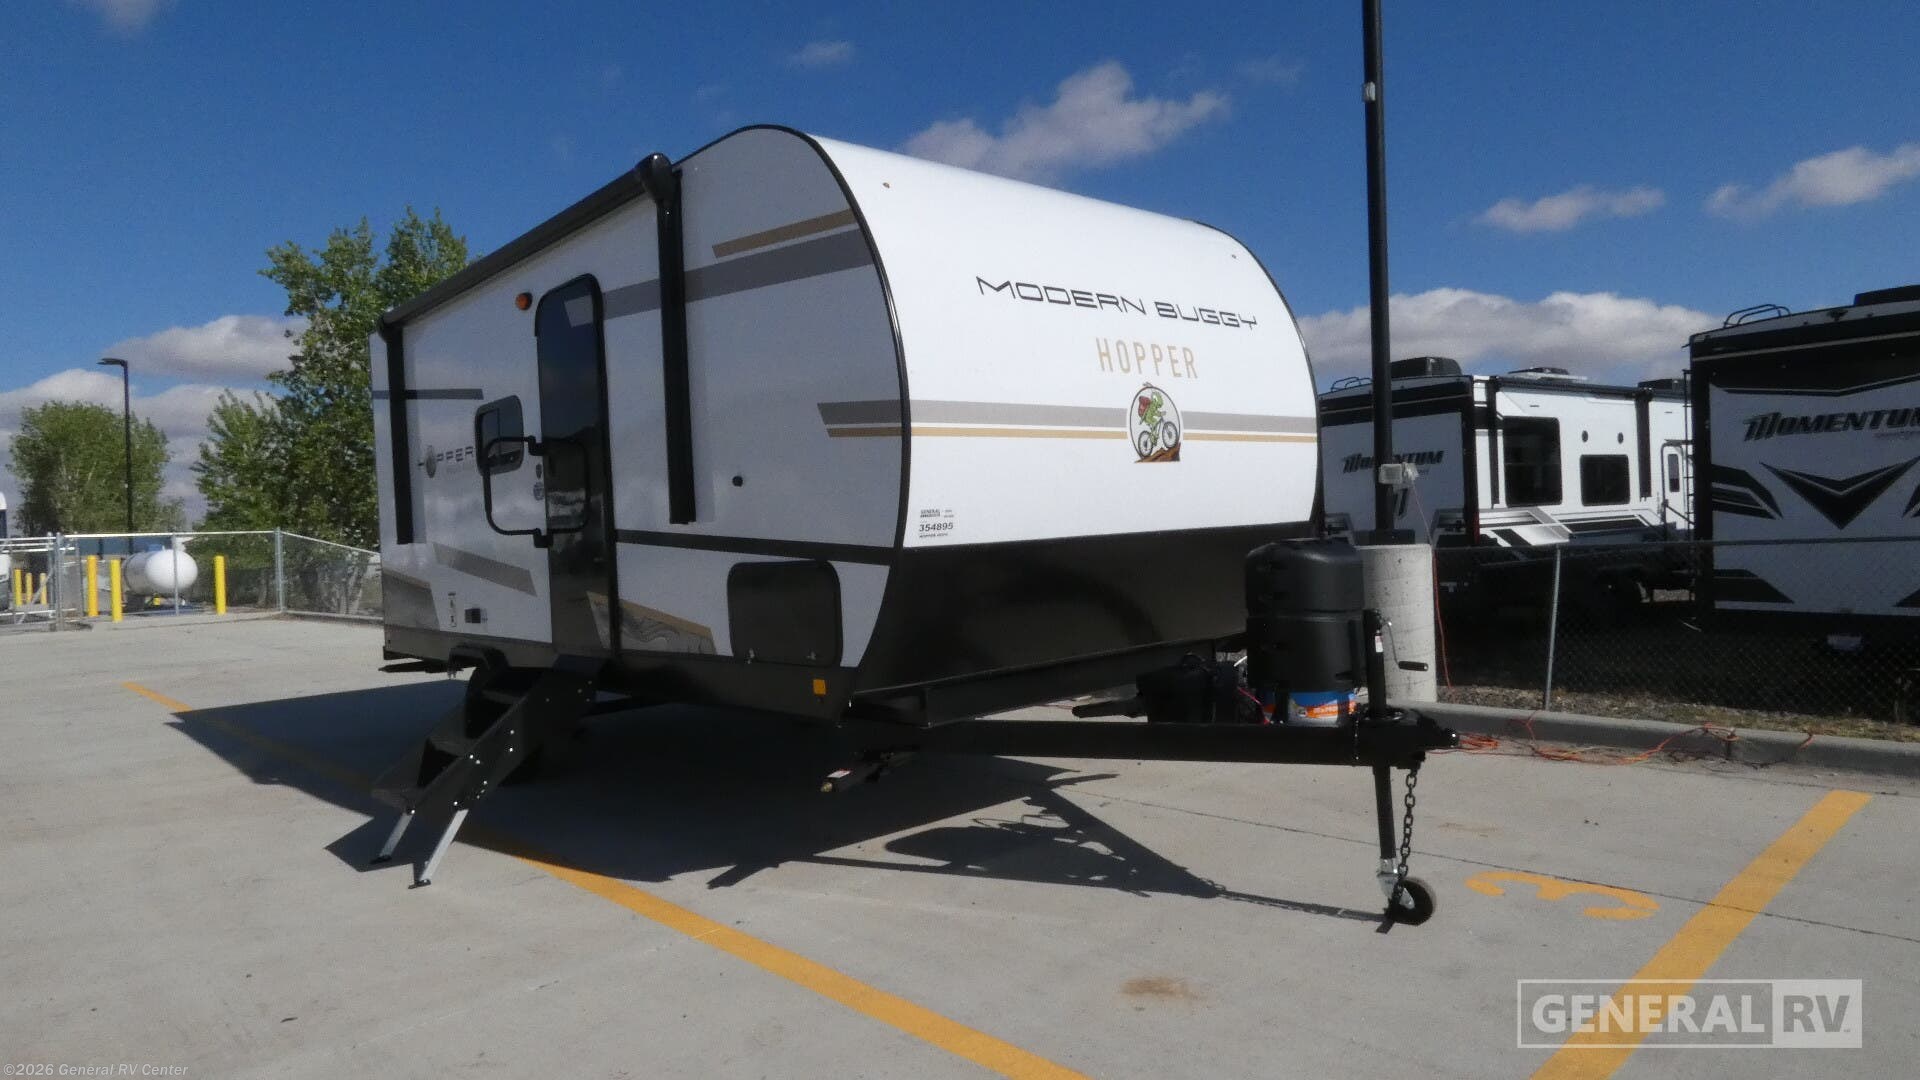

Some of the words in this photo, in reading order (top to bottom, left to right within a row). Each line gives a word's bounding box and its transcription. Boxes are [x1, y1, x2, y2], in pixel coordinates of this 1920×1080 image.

[975, 275, 1147, 315] MODERN
[1154, 301, 1258, 330] BUGGY
[1095, 337, 1199, 379] HOPPER
[1341, 450, 1444, 473] MONTUM
[919, 522, 954, 532] 354895
